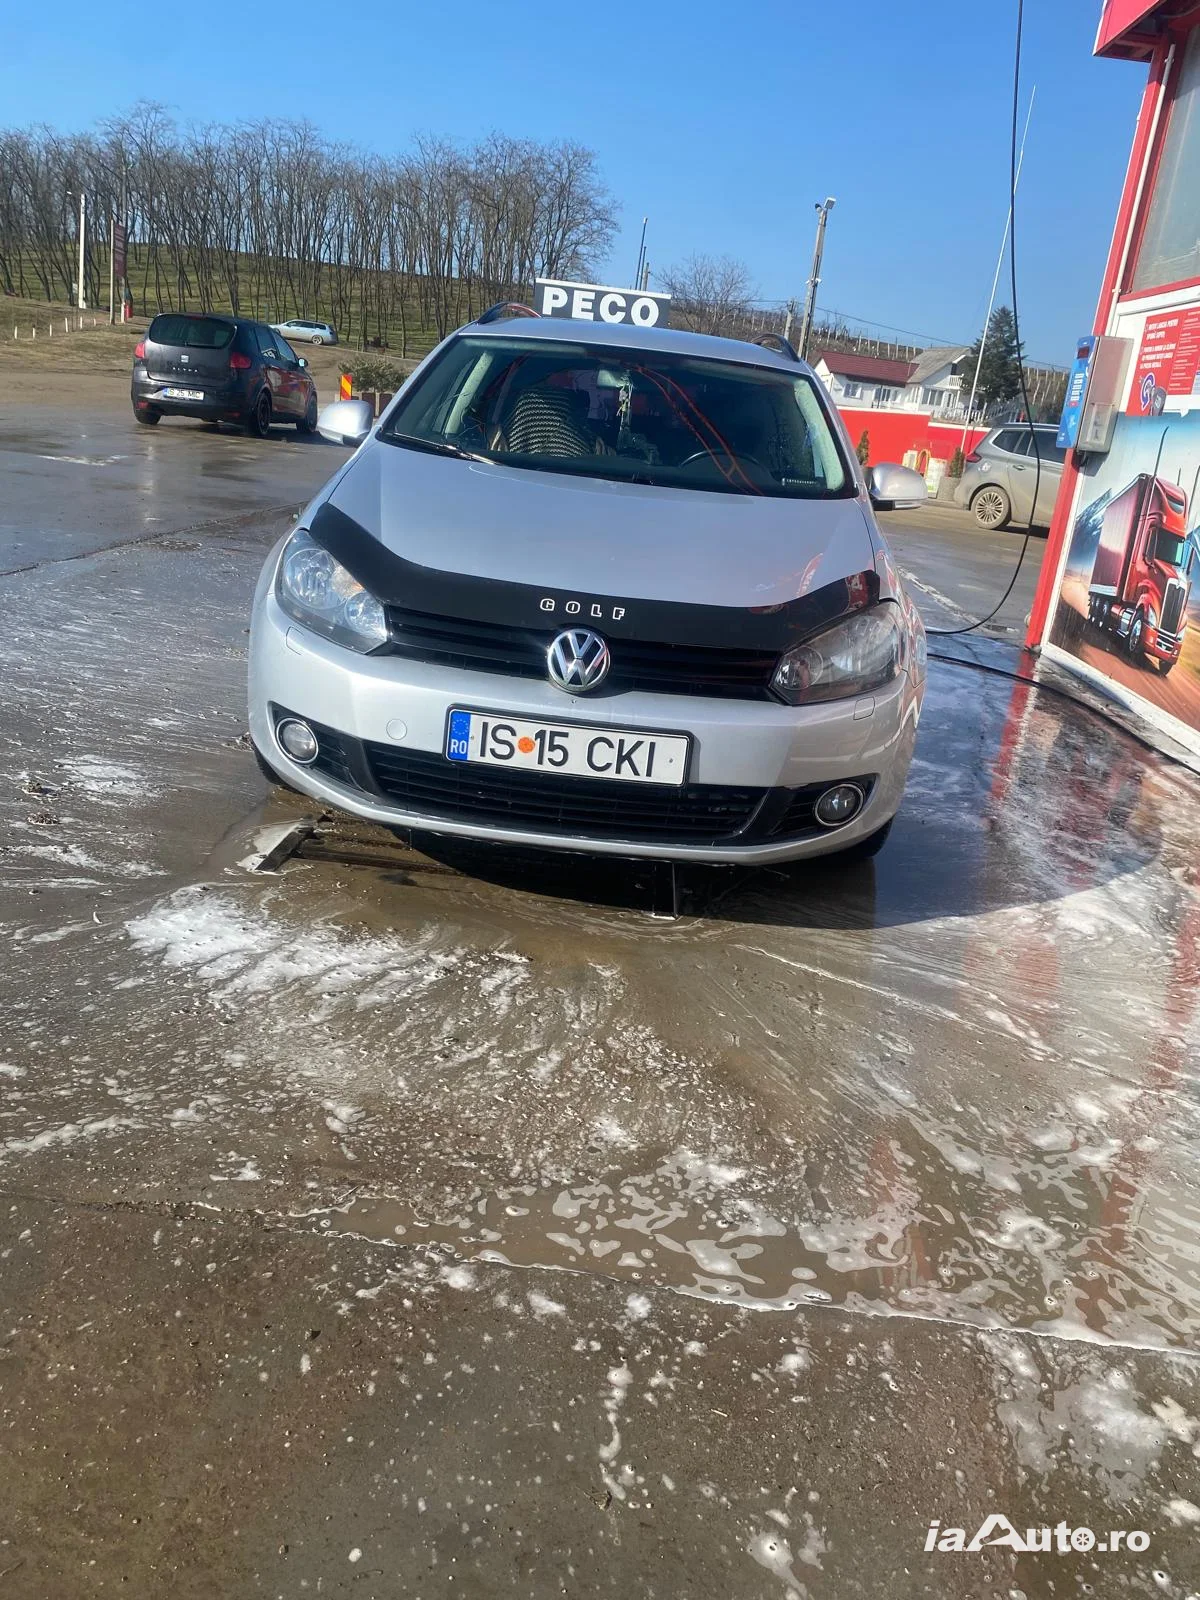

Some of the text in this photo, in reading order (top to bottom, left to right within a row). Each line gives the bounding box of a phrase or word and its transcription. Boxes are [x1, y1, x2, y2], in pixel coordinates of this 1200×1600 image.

[542, 286, 660, 327] PECO
[539, 598, 625, 620] GOLF
[450, 739, 467, 755] RO
[479, 721, 656, 778] IS 15 CKI
